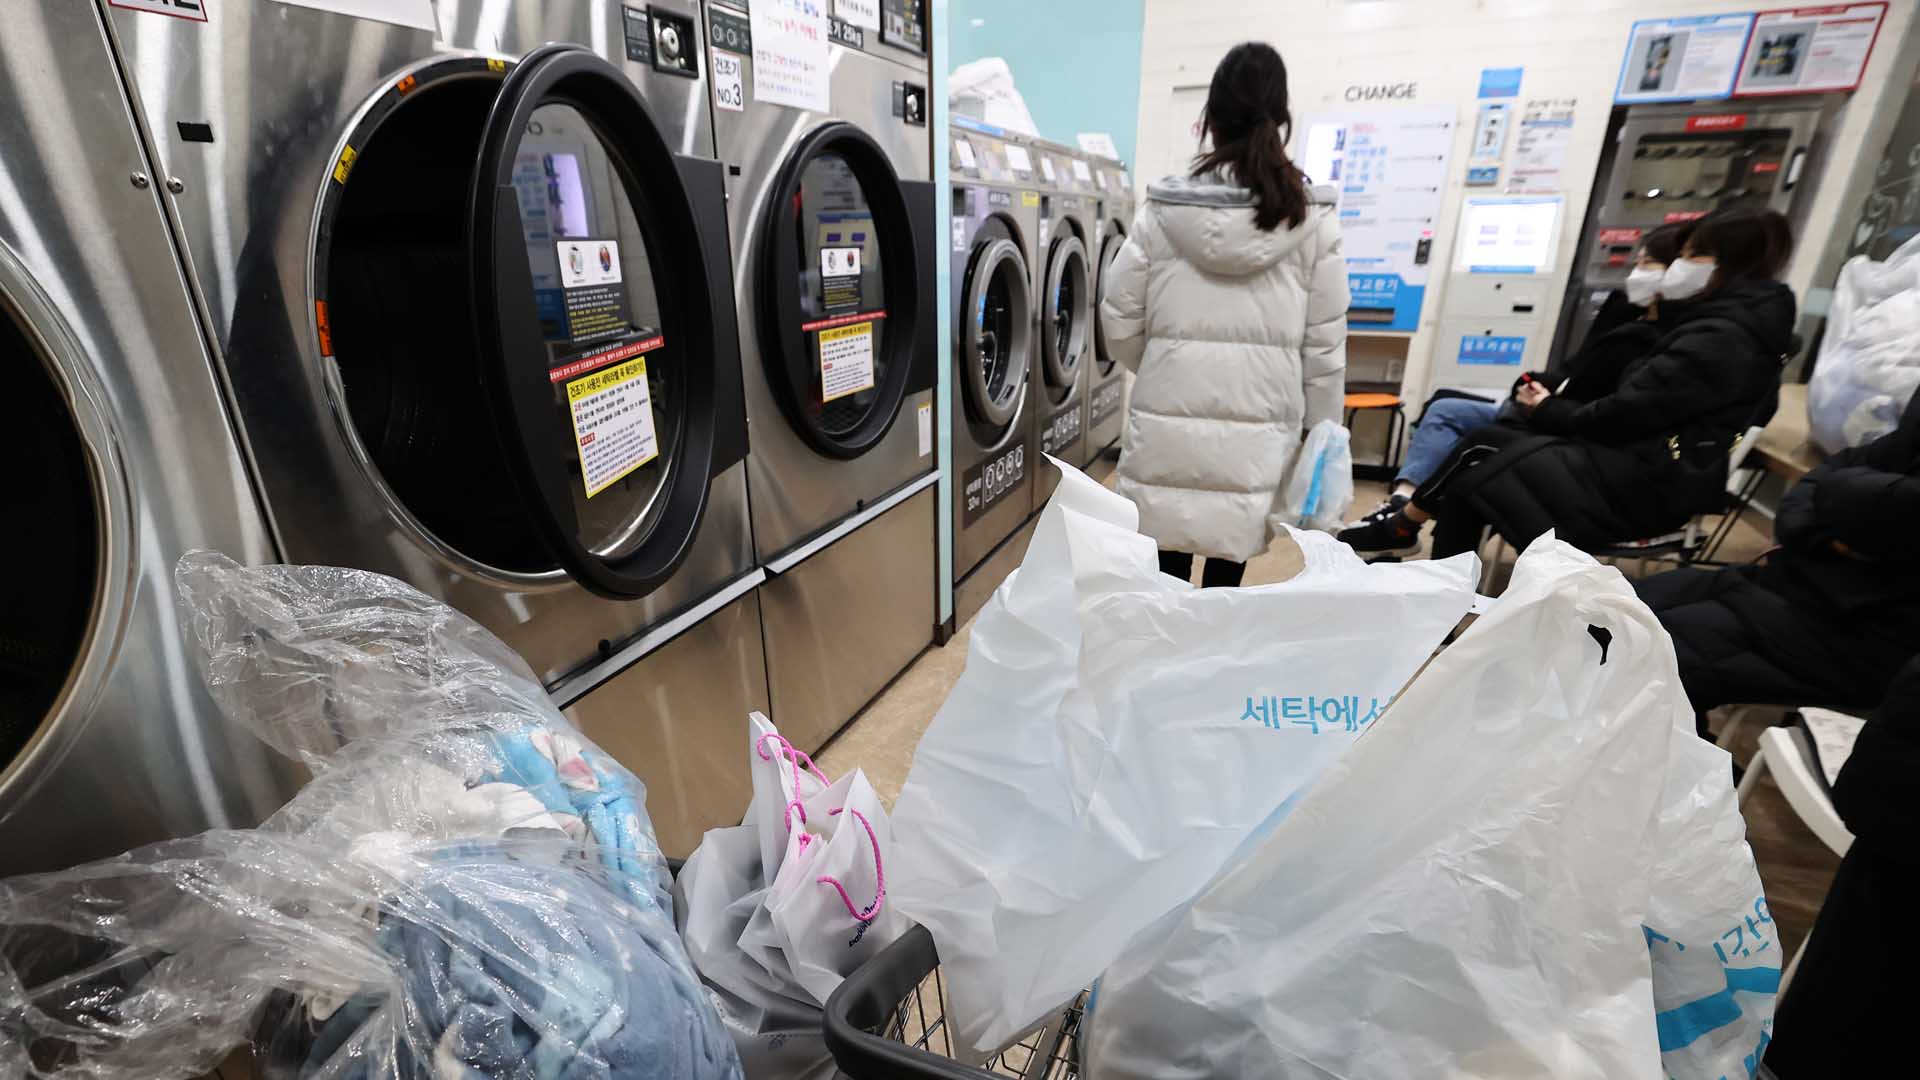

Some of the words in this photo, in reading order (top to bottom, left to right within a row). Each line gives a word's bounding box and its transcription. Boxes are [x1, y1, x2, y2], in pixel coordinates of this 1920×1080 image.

[714, 57, 740, 78] 건조기
[717, 84, 742, 106] NO.3
[1344, 82, 1418, 103] CHANGE
[570, 384, 586, 398] 건조기
[586, 377, 601, 391] 사용전
